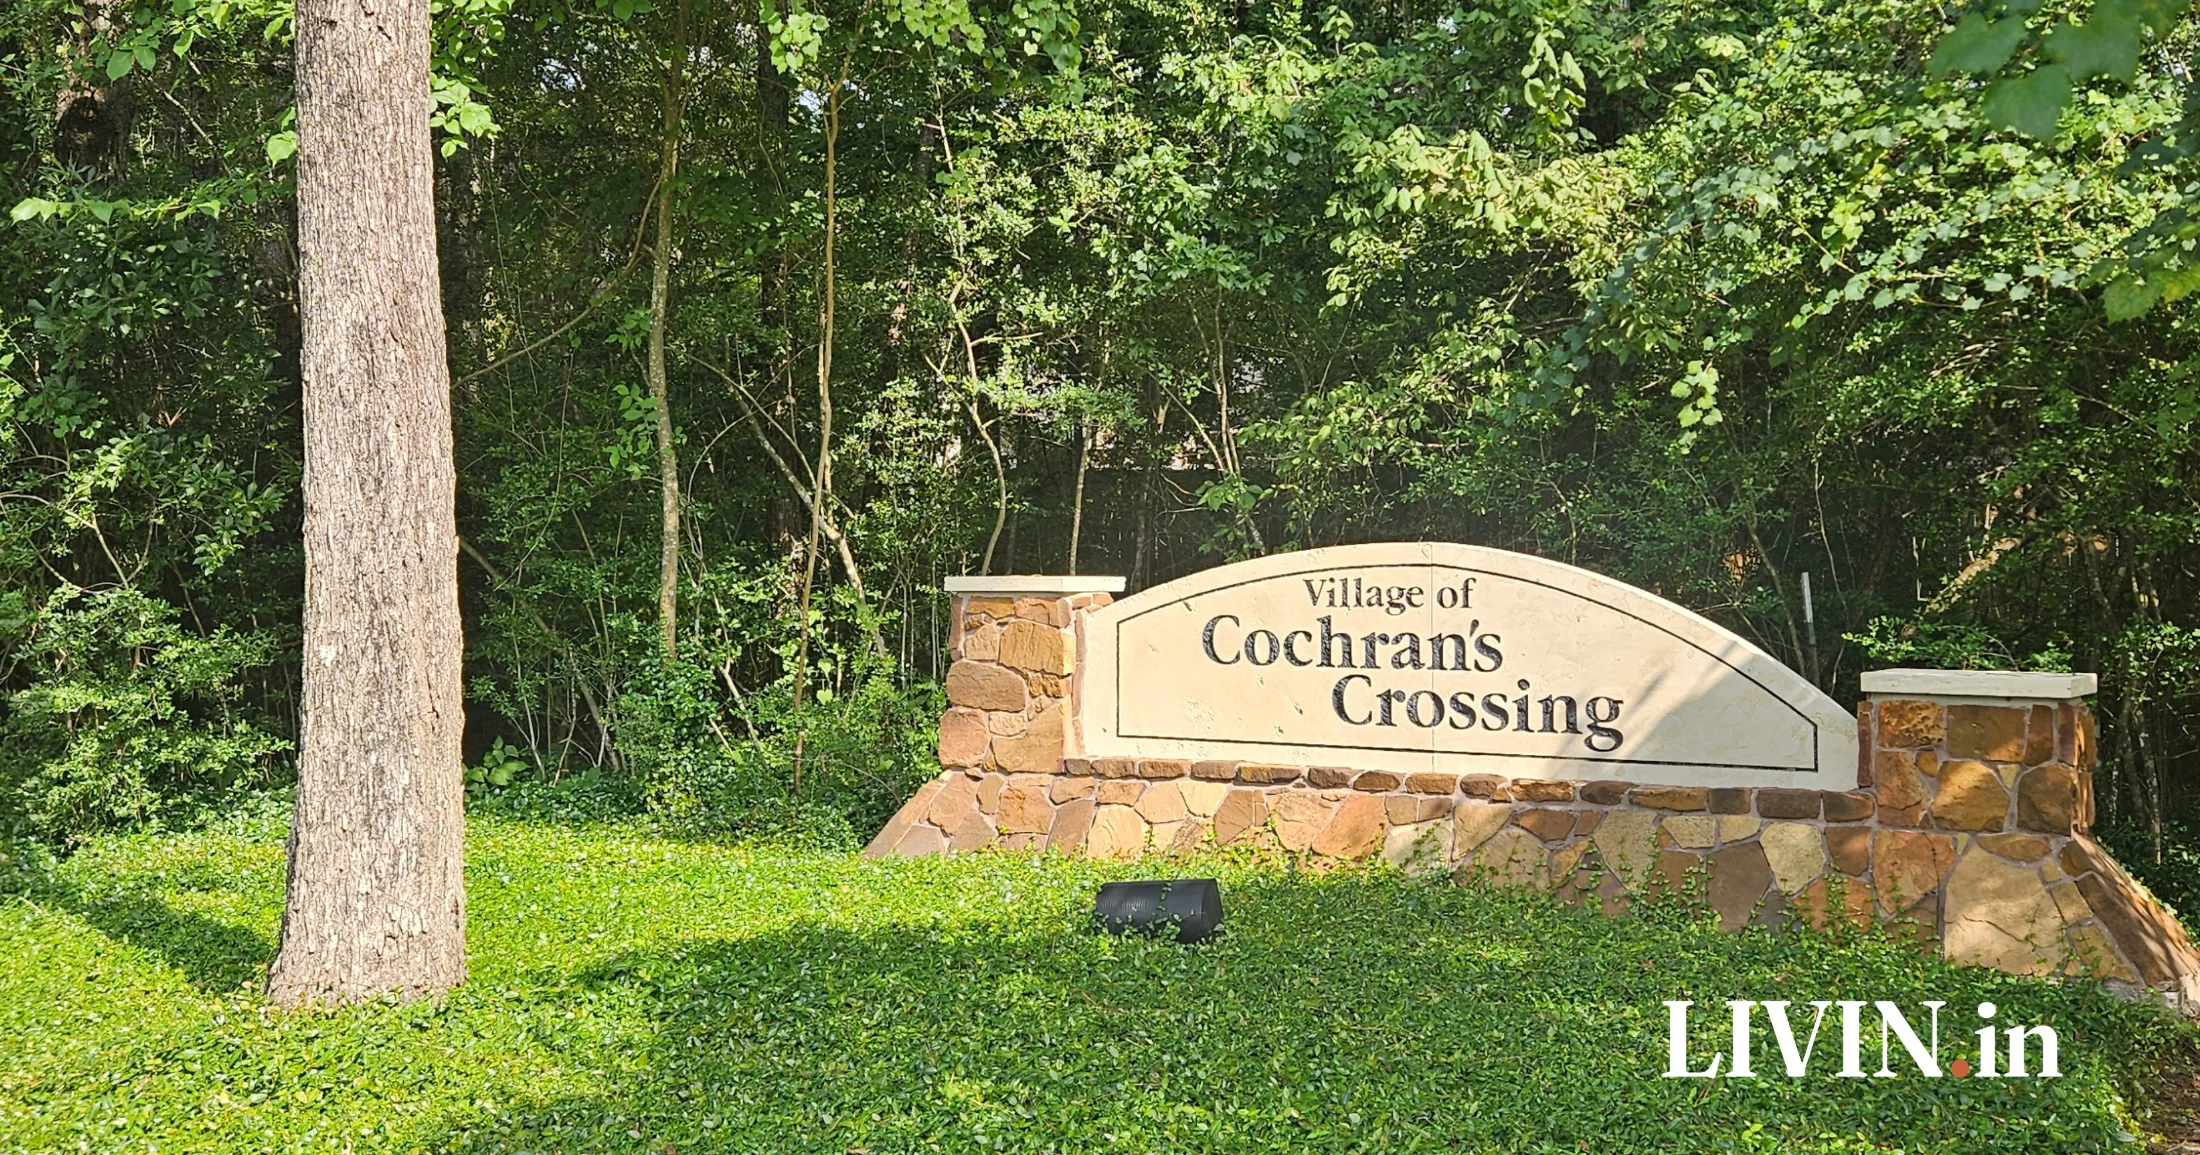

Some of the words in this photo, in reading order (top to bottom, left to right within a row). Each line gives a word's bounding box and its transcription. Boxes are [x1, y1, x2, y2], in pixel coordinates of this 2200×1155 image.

[1303, 577, 1424, 616] Village
[1437, 576, 1477, 609] of
[1201, 614, 1503, 673] Cochran's
[1331, 674, 1625, 752] Crossing
